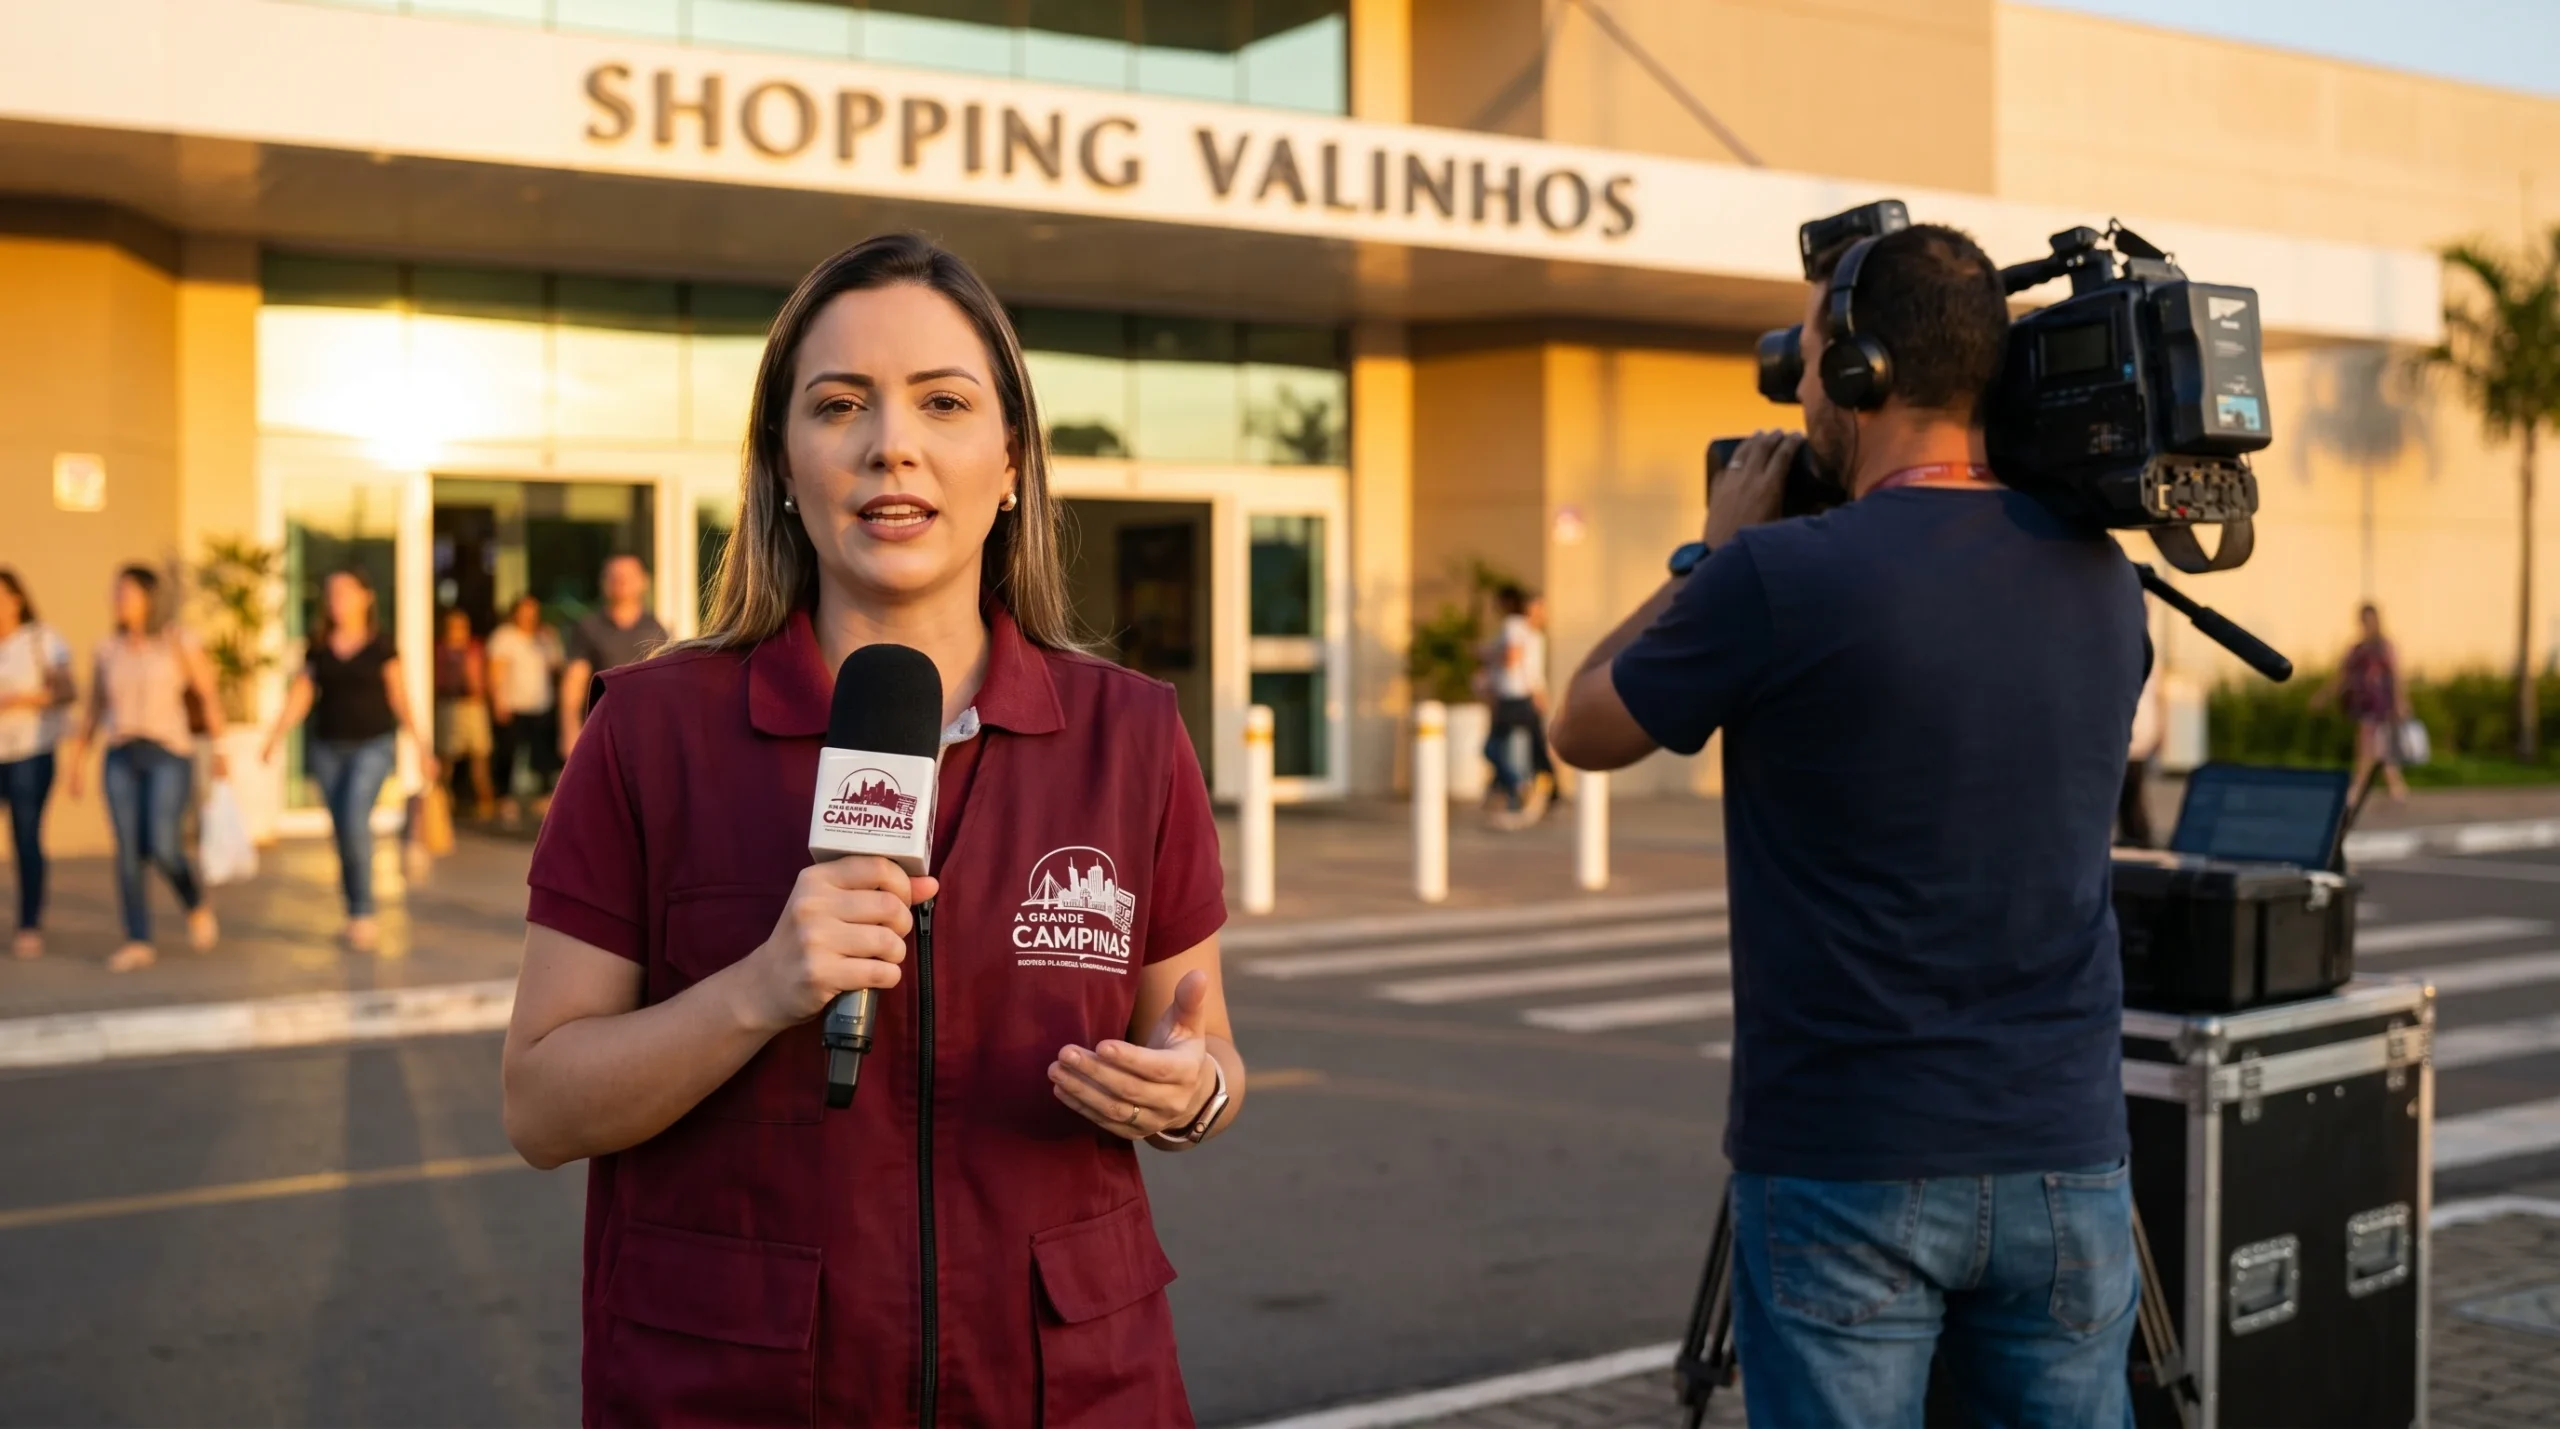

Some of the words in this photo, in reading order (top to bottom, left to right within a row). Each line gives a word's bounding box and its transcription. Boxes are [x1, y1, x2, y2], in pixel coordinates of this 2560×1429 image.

[583, 63, 1142, 190] SHOPPING
[1196, 128, 1637, 237] VALINHOS
[823, 810, 914, 831] CAMPINAS
[1014, 912, 1024, 923] A
[1029, 912, 1084, 924] GRANDE
[1012, 925, 1131, 958] CAMPINAS
